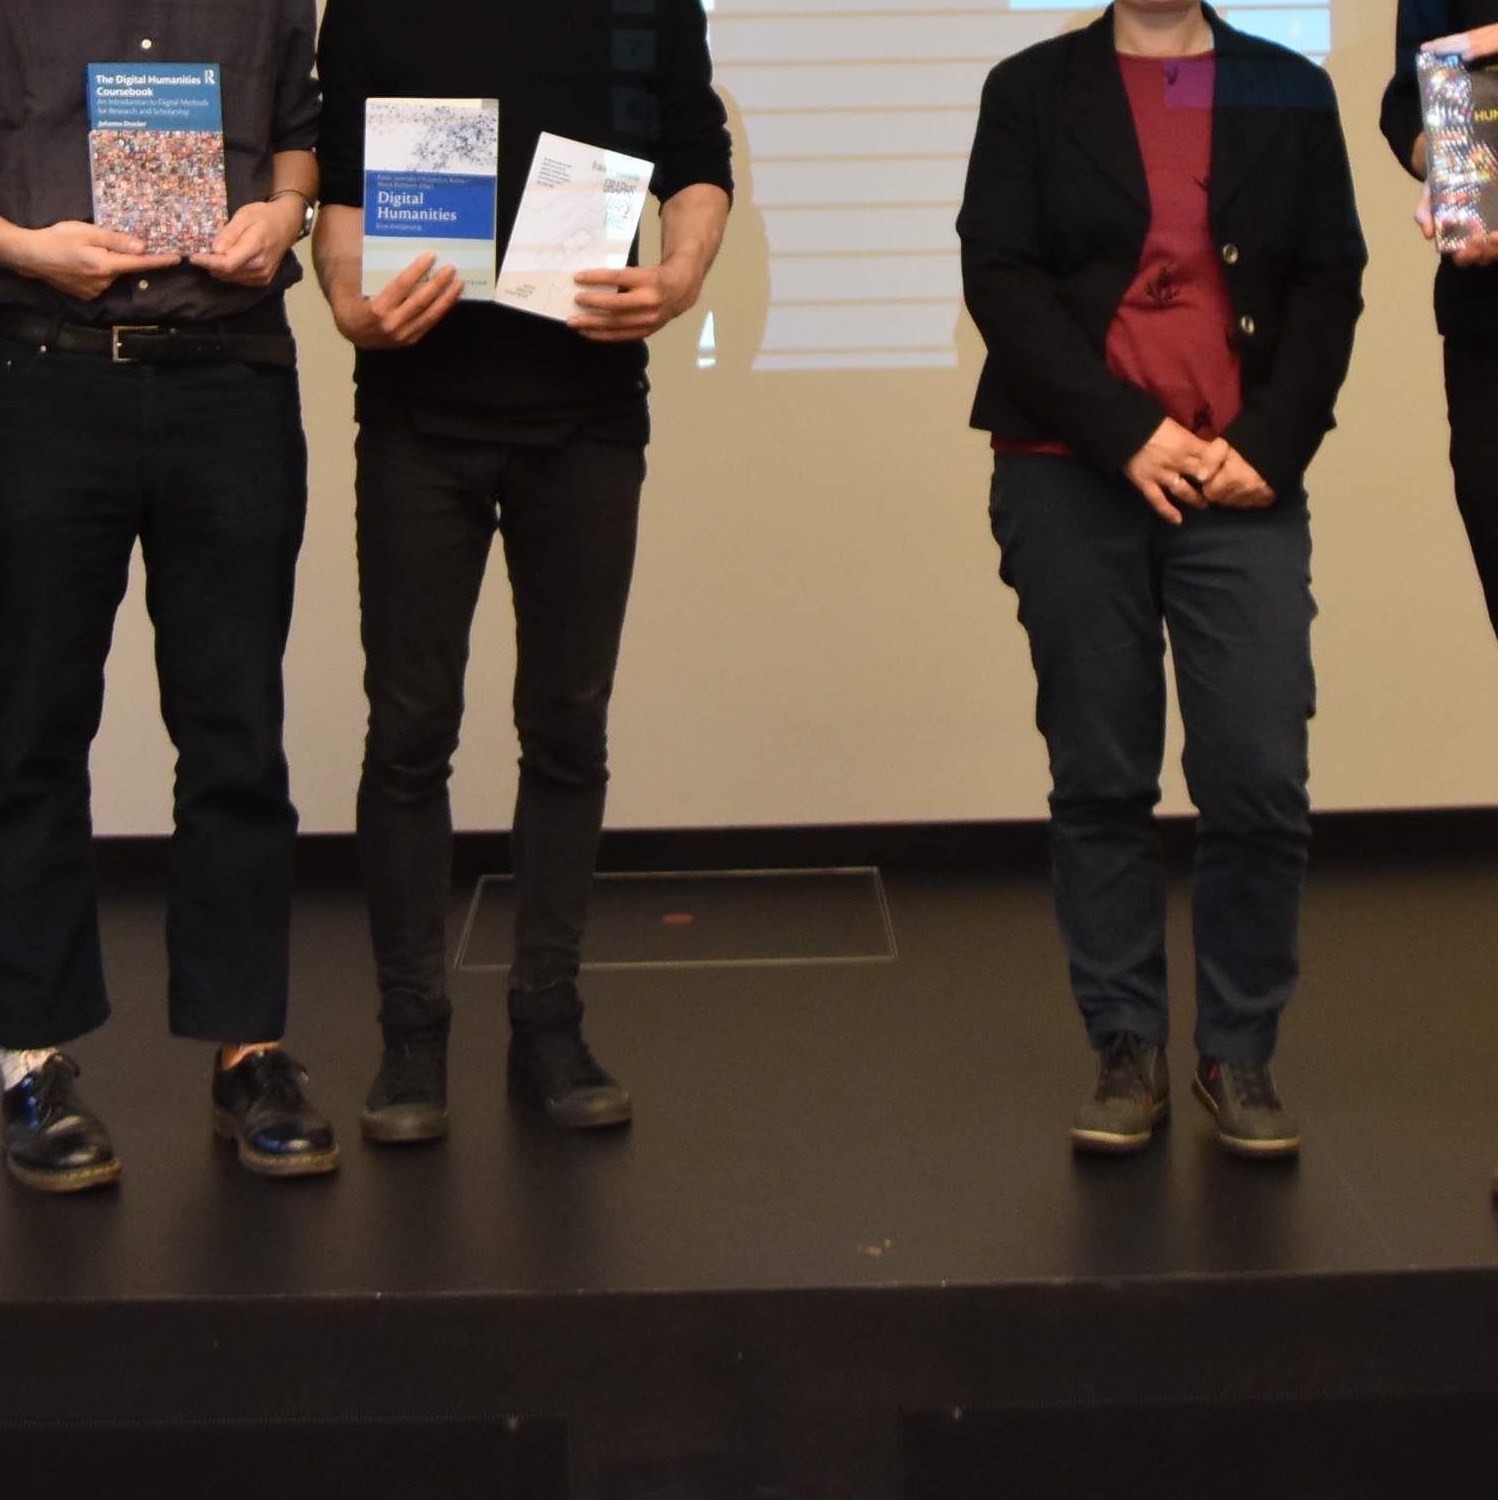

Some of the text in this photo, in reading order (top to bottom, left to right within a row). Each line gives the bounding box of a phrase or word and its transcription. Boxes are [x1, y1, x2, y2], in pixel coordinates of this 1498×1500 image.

[96, 75, 201, 86] The Digital Humanities
[97, 87, 154, 97] Coursebook
[378, 191, 424, 207] Digital
[377, 207, 457, 221] Humanities
